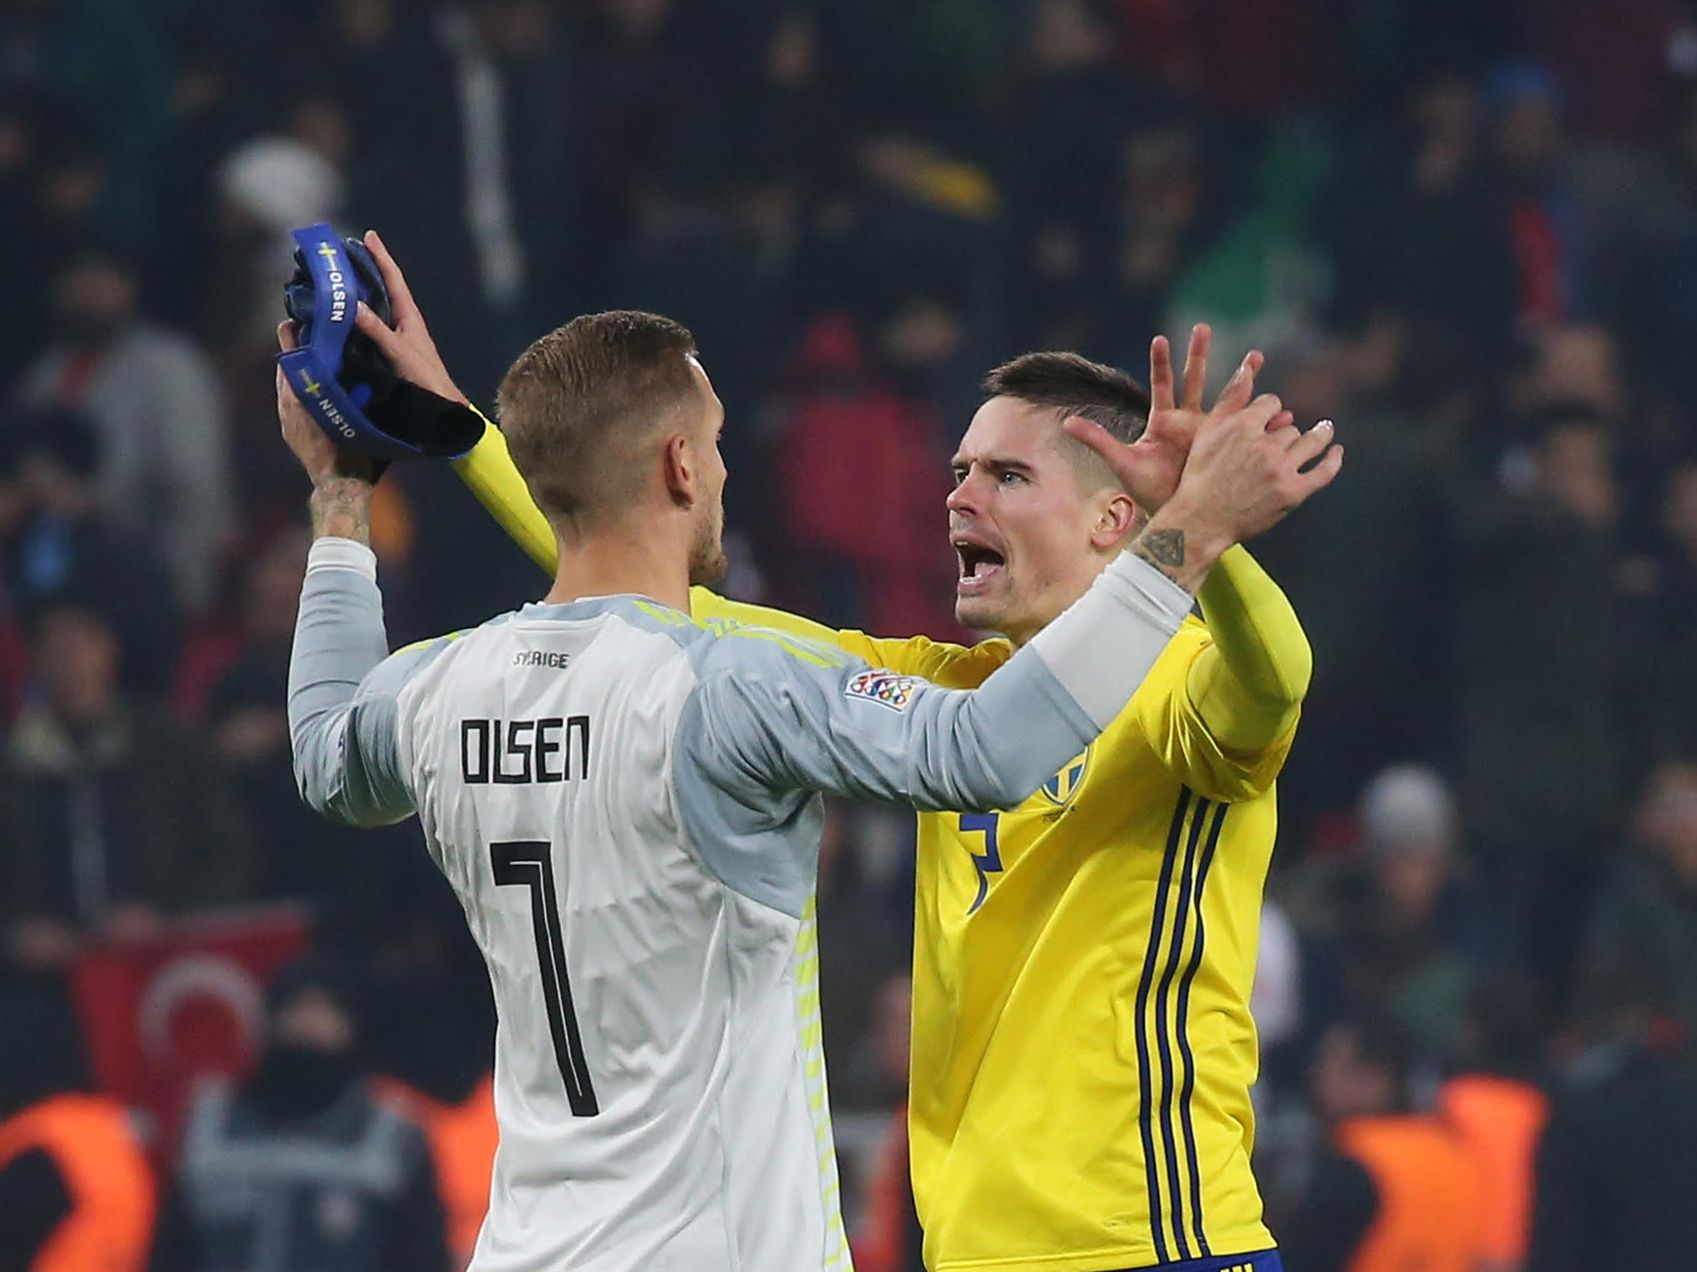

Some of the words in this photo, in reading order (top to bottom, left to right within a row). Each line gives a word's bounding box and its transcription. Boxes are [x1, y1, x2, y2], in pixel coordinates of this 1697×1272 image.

[328, 271, 346, 322] OLSEN
[318, 398, 356, 439] OLSEN
[461, 715, 589, 784] OLSEN
